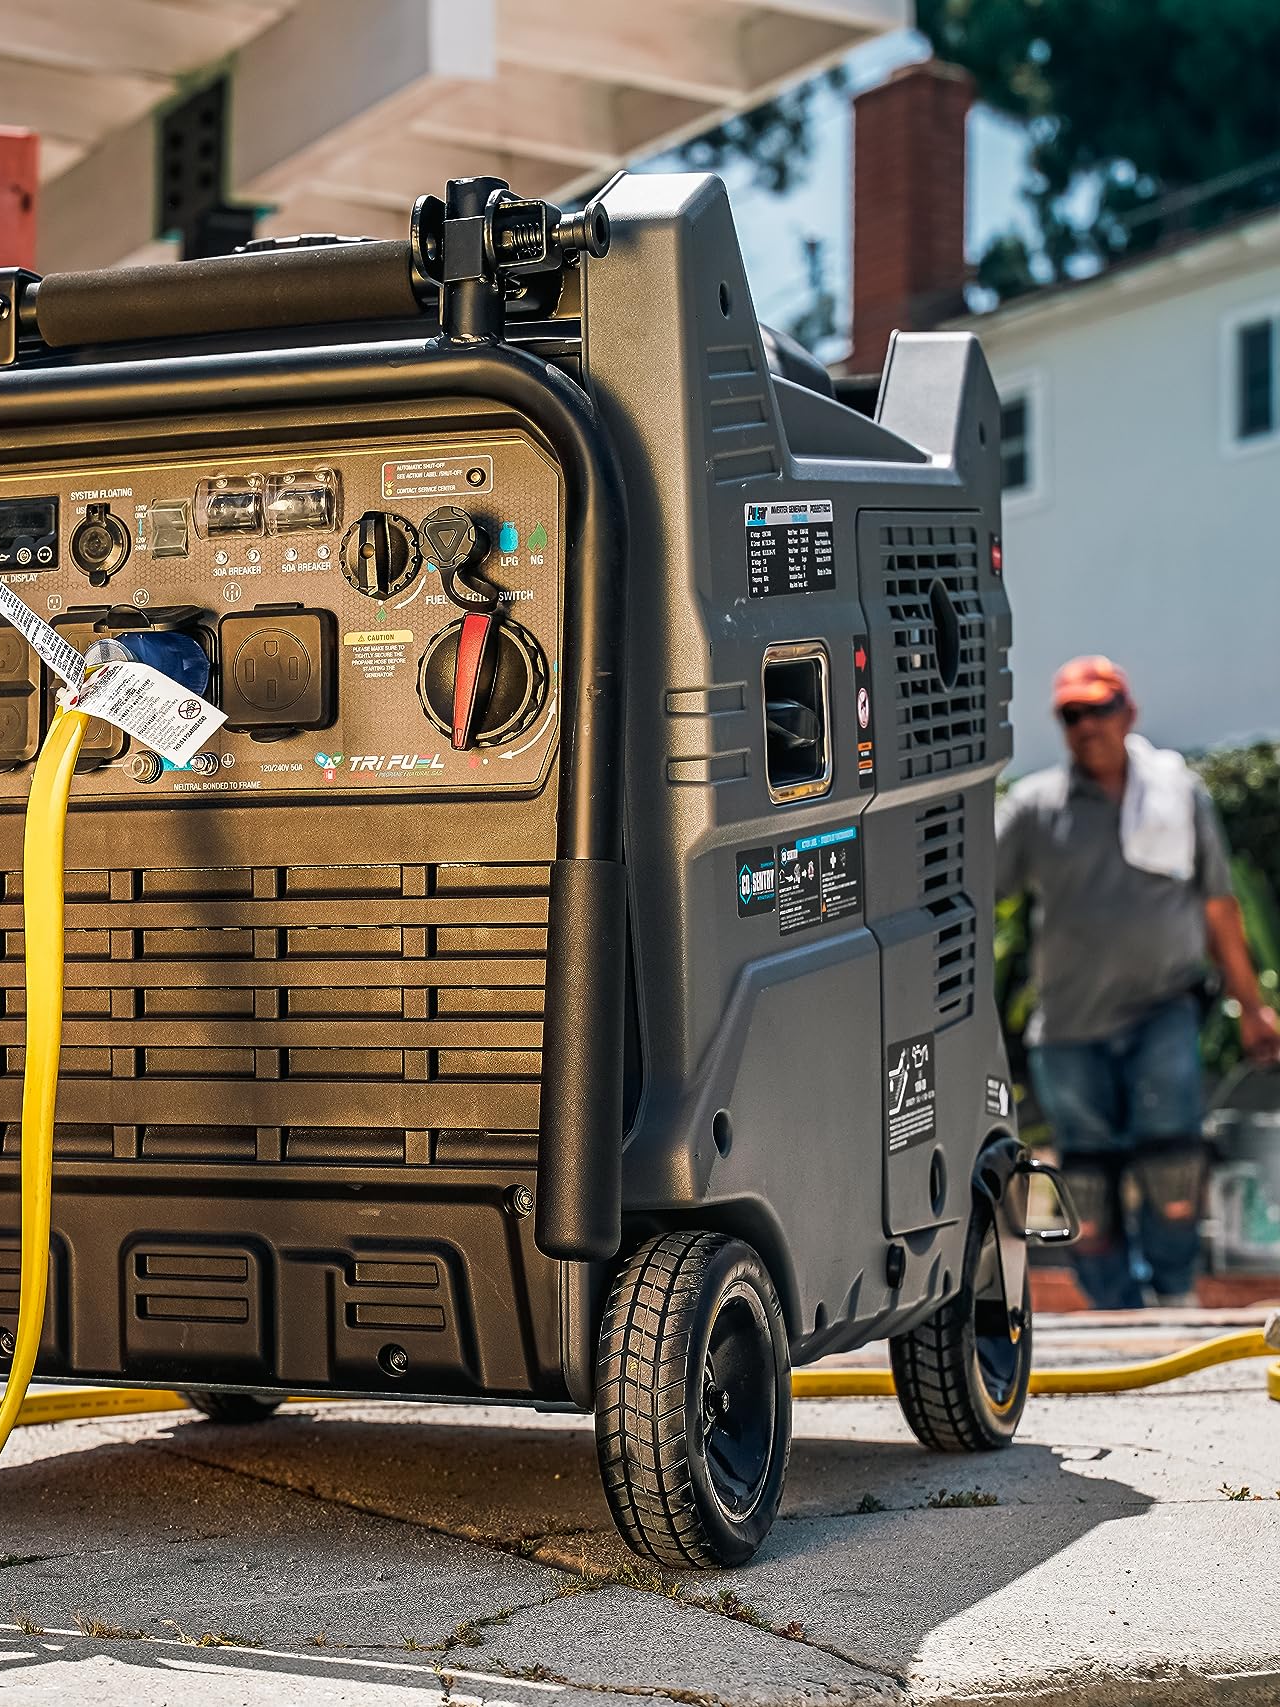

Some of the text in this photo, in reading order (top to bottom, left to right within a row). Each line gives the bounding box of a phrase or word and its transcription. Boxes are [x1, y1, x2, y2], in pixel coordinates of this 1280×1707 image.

[396, 463, 422, 471] AUTOMATIC
[70, 488, 132, 500] SYSTEM FLOATING
[500, 556, 519, 566] LPG
[530, 555, 544, 565] NG
[212, 566, 262, 577] 30A BREAKER
[282, 562, 331, 572] 50A BREAKER
[10, 574, 38, 582] DISPLAY
[426, 595, 448, 605] FUEL
[498, 590, 534, 601] SWITCH
[387, 753, 445, 770] FUEL
[260, 764, 290, 772] 120/240V
[173, 782, 201, 791] NEUTRAL
[203, 782, 228, 790] BONDED
[240, 781, 261, 789] FRAME
[753, 869, 774, 892] SENTRY
